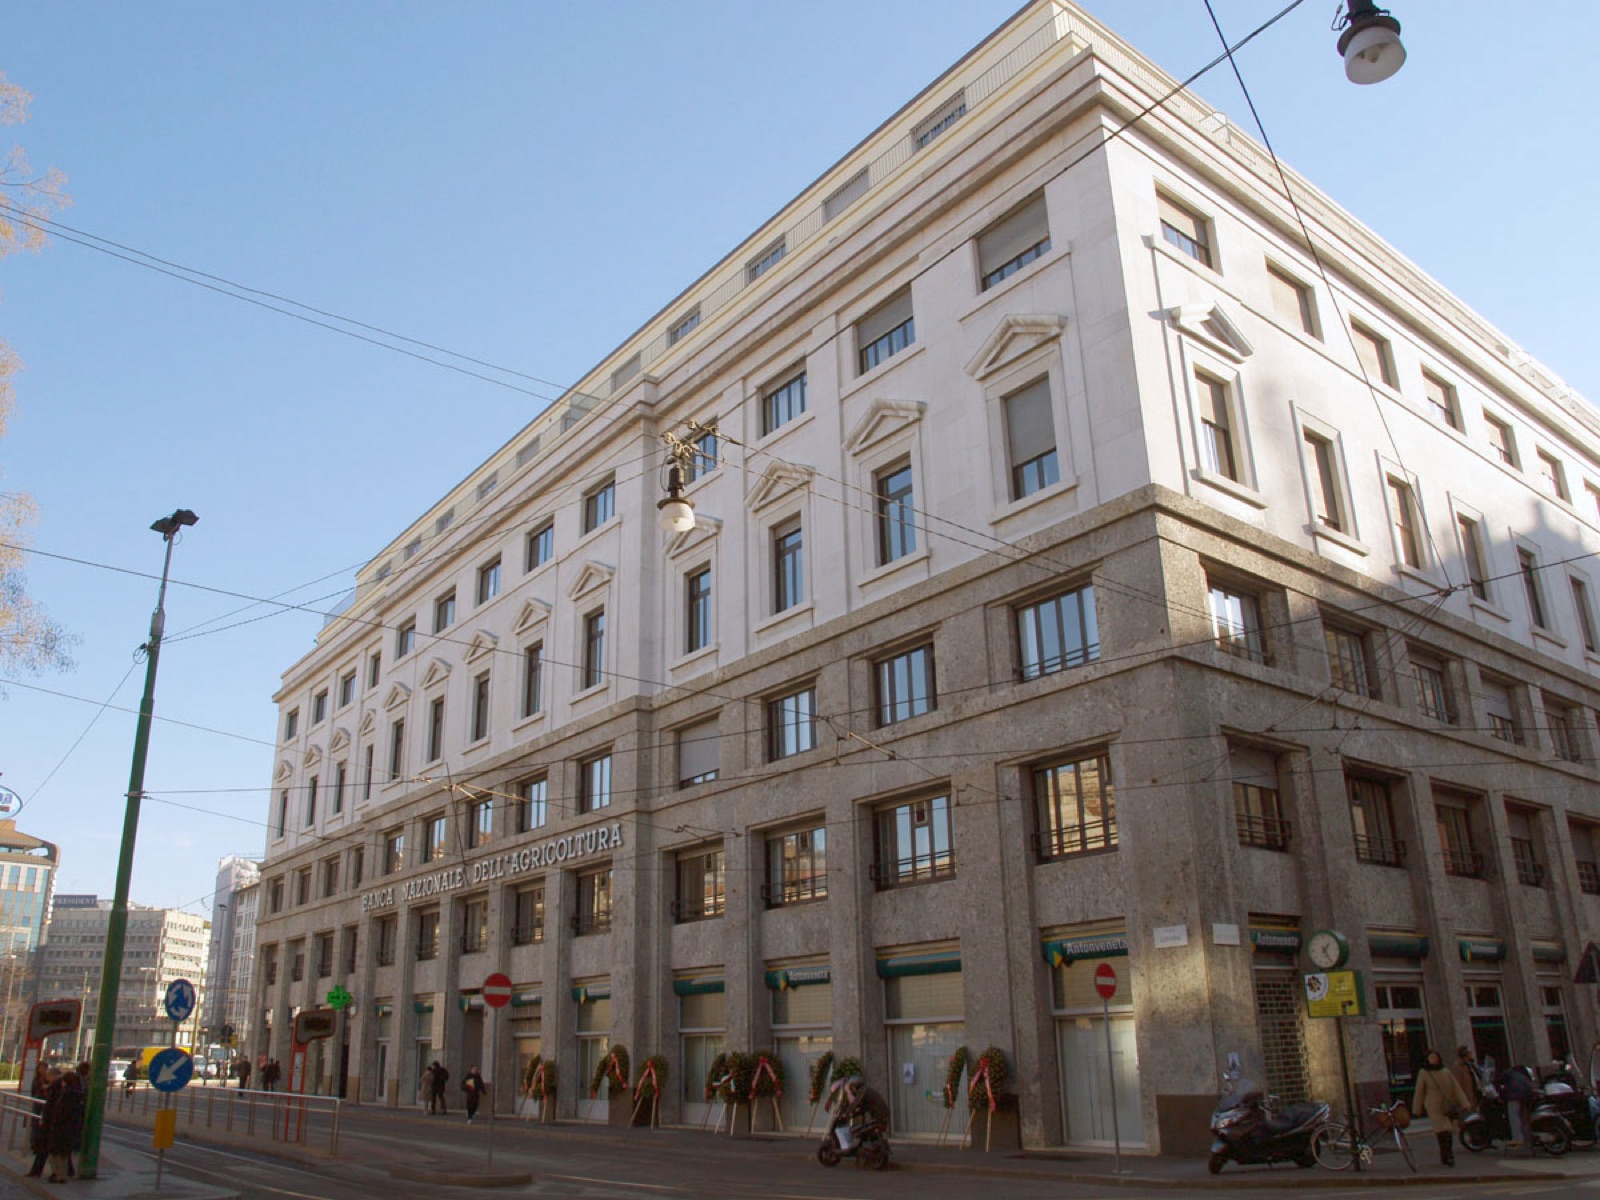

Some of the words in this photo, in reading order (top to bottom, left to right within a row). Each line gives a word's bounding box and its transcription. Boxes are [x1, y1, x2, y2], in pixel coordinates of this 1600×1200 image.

[363, 887, 393, 912] BANCA
[403, 868, 463, 900] NAZIONALE
[472, 823, 622, 884] DELL'AGRICOLTURA
